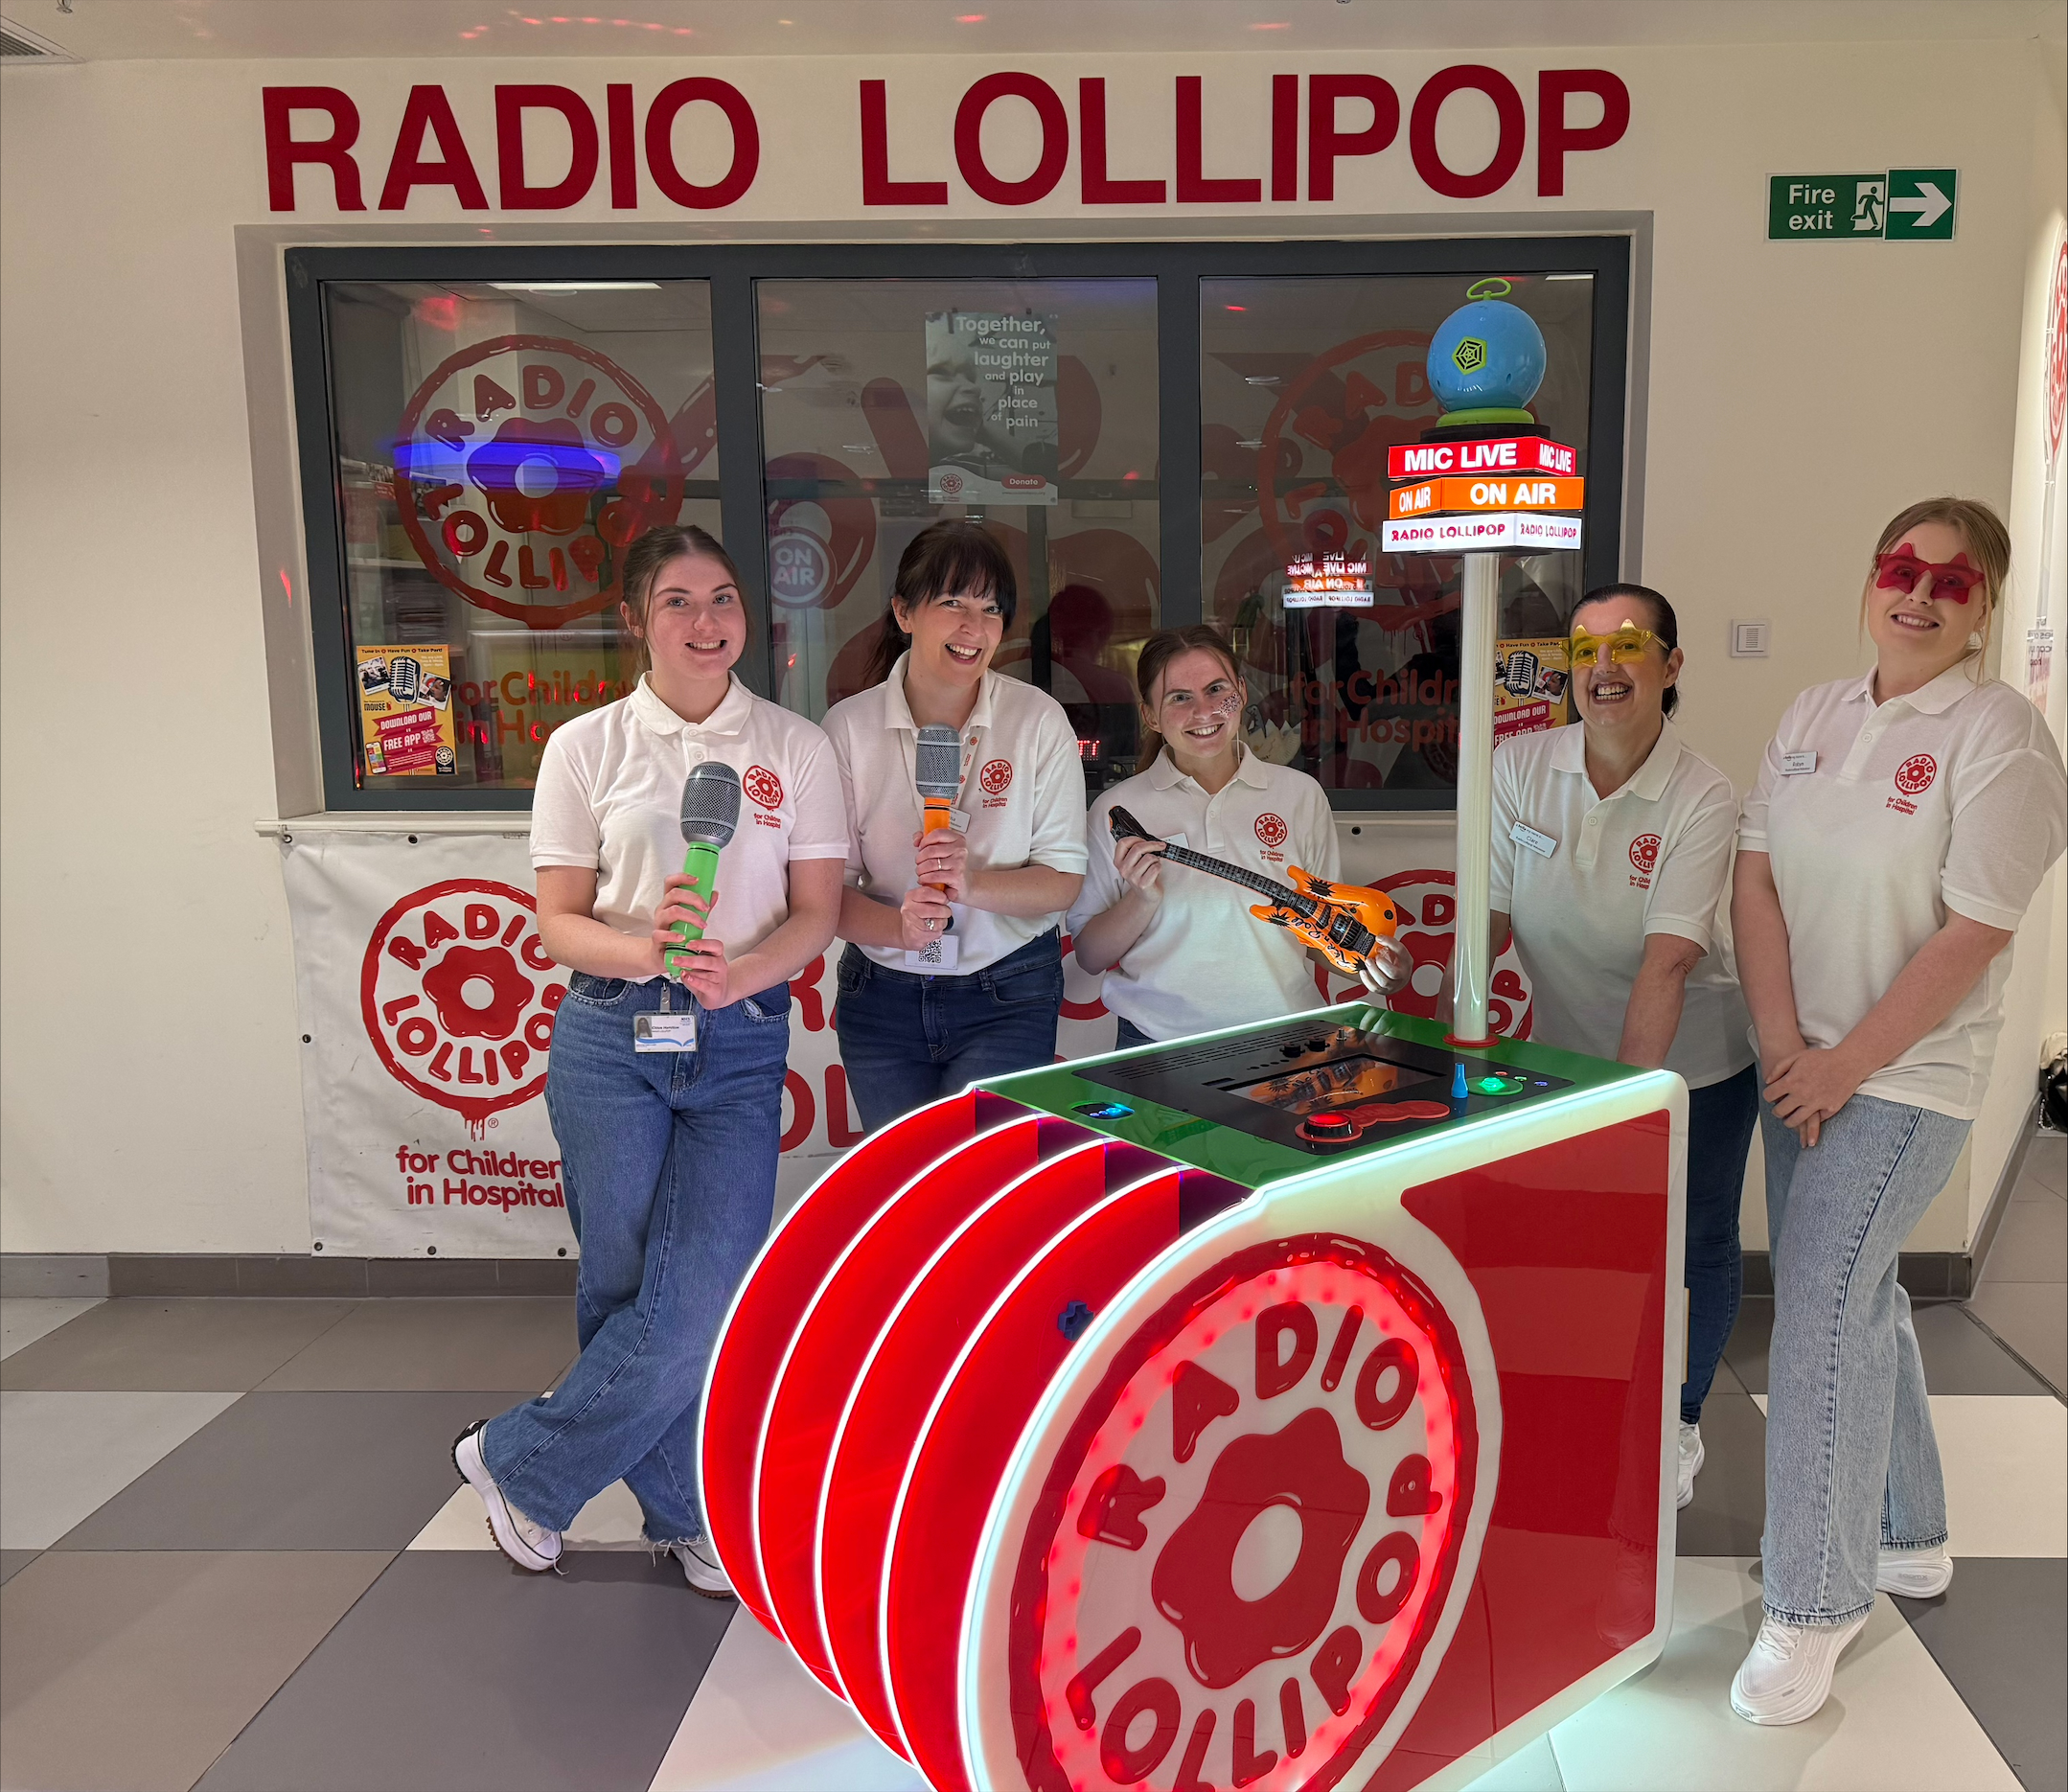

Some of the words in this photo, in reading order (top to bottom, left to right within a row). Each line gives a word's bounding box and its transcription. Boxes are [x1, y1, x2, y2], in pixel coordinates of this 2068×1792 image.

[263, 77, 760, 211] RADIO
[860, 64, 1630, 205] LOLLIPOP
[1788, 184, 1836, 205] Fire
[1788, 210, 1833, 230] exit
[955, 316, 1045, 335] Together,
[999, 338, 1028, 349] can
[1032, 340, 1050, 351] put
[975, 352, 1048, 369] laughter
[985, 372, 1005, 380] and
[1009, 369, 1044, 385] play
[1014, 386, 1024, 395] in
[425, 364, 638, 452] RADIO
[998, 396, 1038, 411] place
[991, 412, 1001, 421] of
[1006, 415, 1038, 429] pain
[1404, 447, 1454, 472] MIC
[1460, 443, 1517, 468] LIVE
[1539, 444, 1555, 469] MIC
[1555, 449, 1572, 472] LIVE
[1399, 491, 1413, 513] ON
[1413, 486, 1431, 511] AIR
[1470, 482, 1507, 505] ON
[1513, 483, 1556, 505] AIR
[1391, 528, 1435, 541] RADIO
[1439, 524, 1505, 539] LOLLIPOP
[1520, 523, 1543, 536] RADIO
[1546, 525, 1577, 540] LOLLIPOP
[774, 547, 813, 565] ON
[774, 565, 816, 586] AIR
[1289, 670, 1344, 705] for
[1346, 669, 1459, 706] Childr
[1532, 704, 1547, 715] OUR
[380, 714, 417, 730] DOWNLOAD
[418, 711, 432, 722] OUR
[456, 711, 489, 745] in
[1339, 707, 1459, 752] Hospit
[383, 737, 402, 751] FREE
[404, 733, 422, 747] APP
[985, 763, 1009, 774] RADIO
[1906, 757, 1934, 772] RADIO
[747, 770, 778, 788] RADIO
[983, 773, 1010, 791] LOLLIPOP
[1898, 771, 1931, 790] LOLLIPOP
[1891, 803, 1916, 816] Hospital
[1896, 798, 1918, 810] Children
[1258, 816, 1283, 827] RADIO
[1257, 828, 1285, 843] LOLLIPOP
[1636, 838, 1661, 847] RADI
[1633, 851, 1655, 869] LOLLIP
[388, 904, 559, 971] RADIO
[396, 1145, 440, 1174] for
[407, 1176, 434, 1206] in
[444, 1178, 565, 1213] Hospital
[1077, 1300, 1420, 1551] RADIO
[1066, 1454, 1443, 1792] LOLLIPOP
